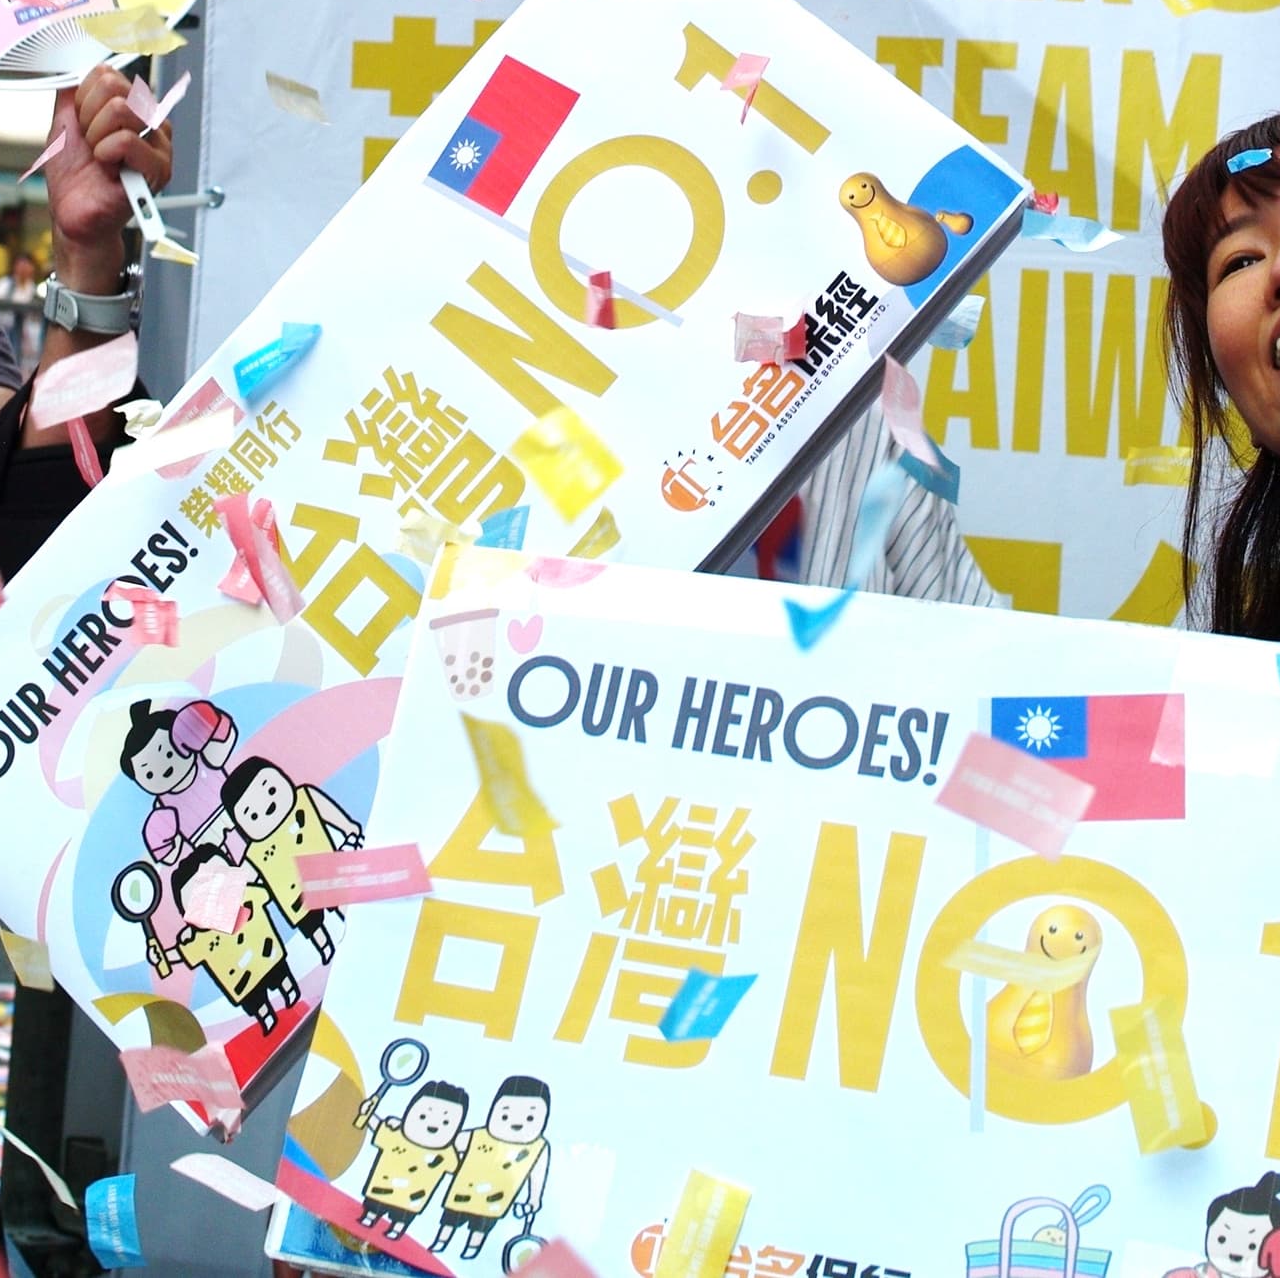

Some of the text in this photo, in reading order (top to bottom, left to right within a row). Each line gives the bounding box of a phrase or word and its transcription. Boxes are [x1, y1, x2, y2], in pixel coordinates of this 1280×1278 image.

[745, 432, 776, 466] TAIMING
[776, 377, 823, 432] ASSURANCE
[822, 341, 855, 379] BROKER
[274, 365, 527, 679] 台灣
[507, 655, 951, 786] OUR HEROES!
[393, 784, 757, 1069] 台灣
